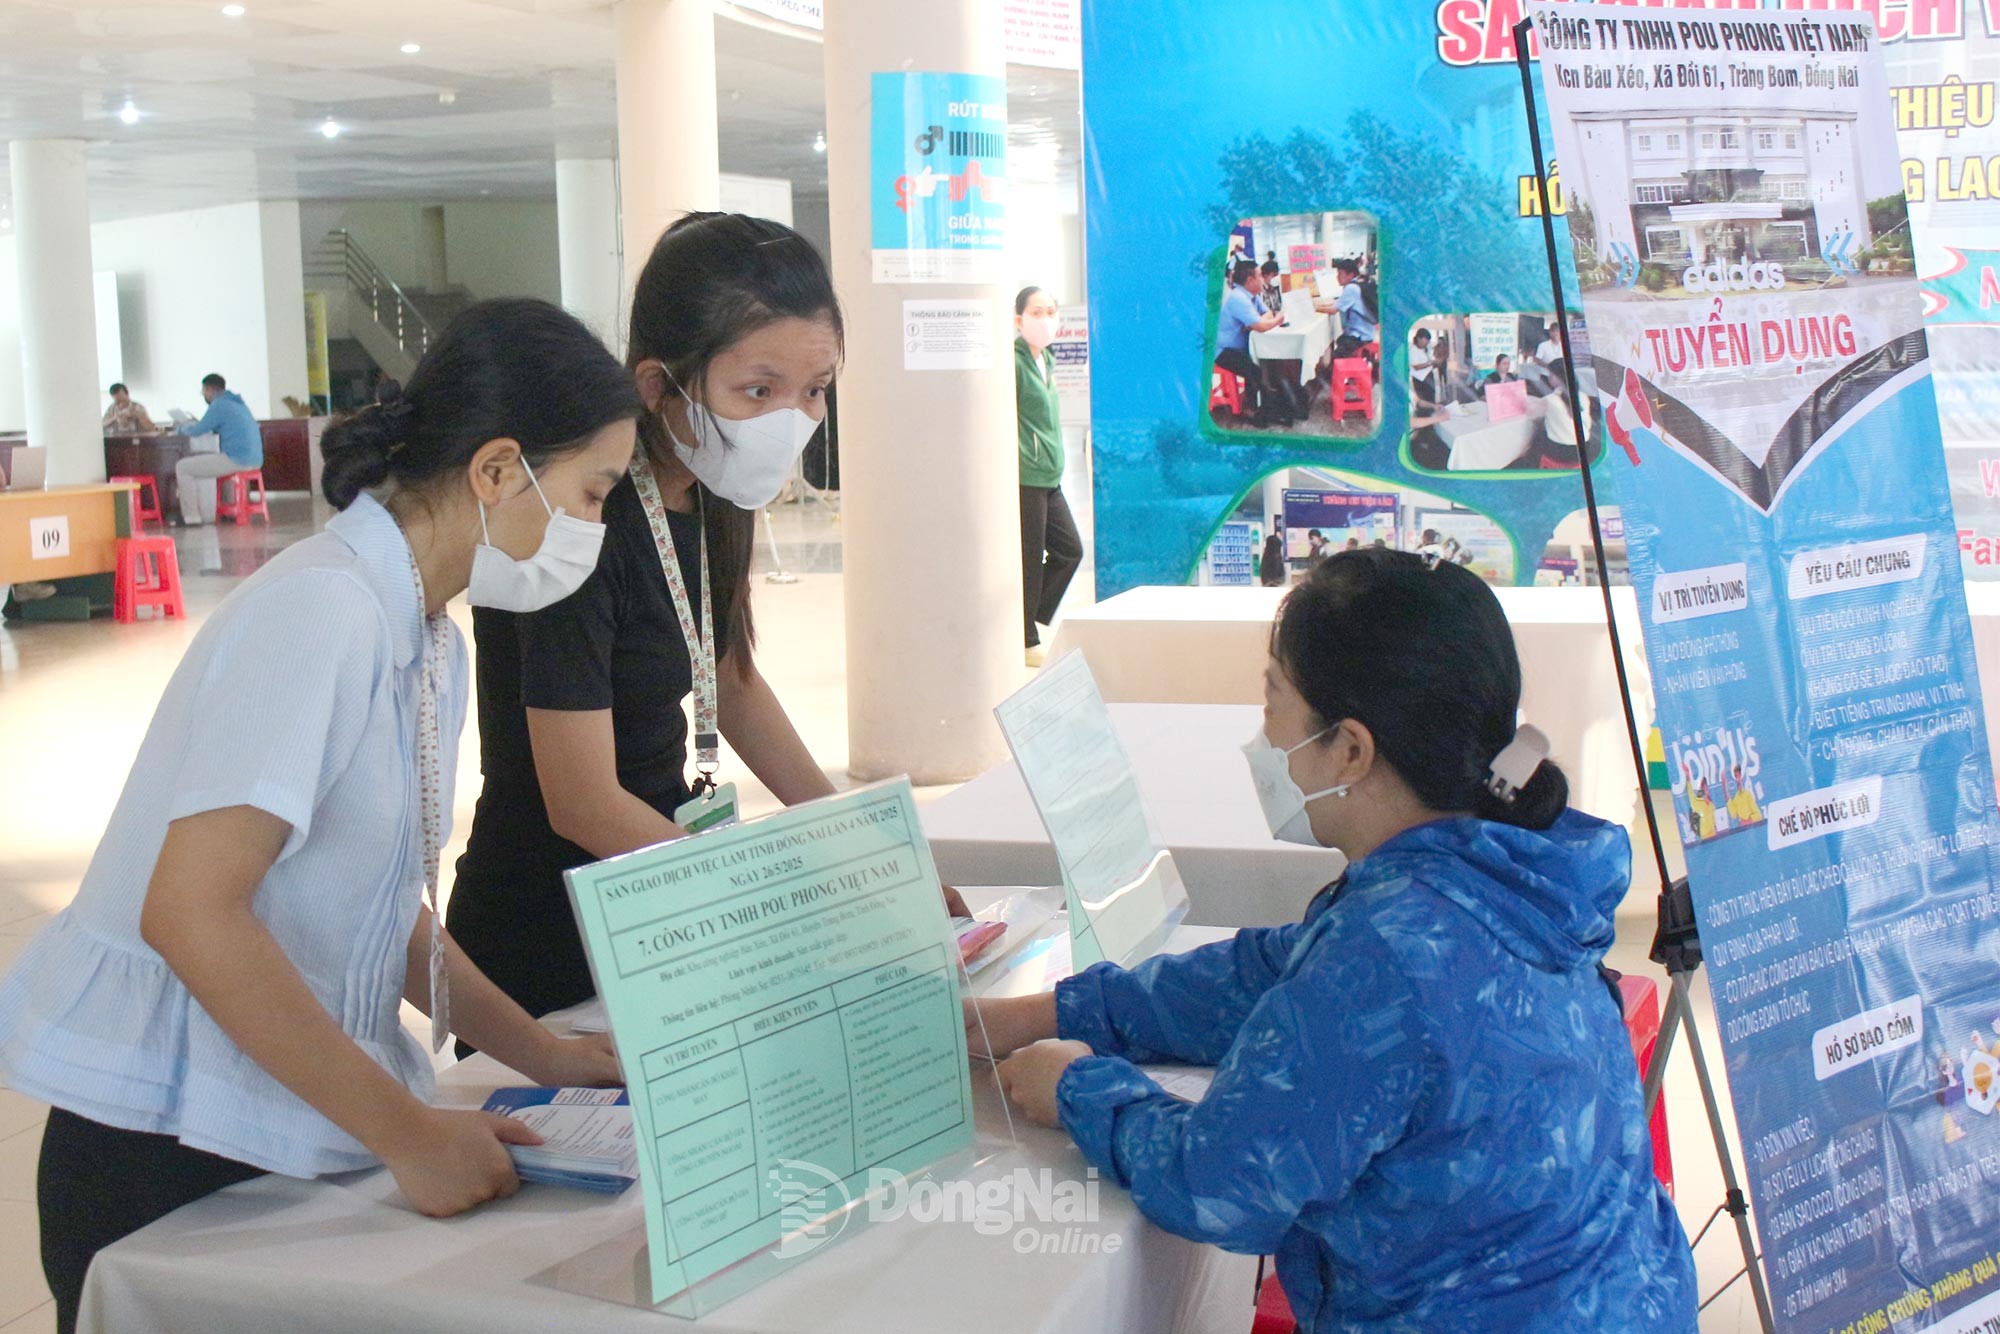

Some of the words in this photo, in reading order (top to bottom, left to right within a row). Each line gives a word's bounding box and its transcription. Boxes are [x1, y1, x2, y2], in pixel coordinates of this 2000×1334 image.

[1537, 9, 1591, 51] CÔNG
[1595, 18, 1618, 50] TY
[1622, 19, 1680, 51] TNHH
[1680, 21, 1719, 51] POU
[1718, 22, 1786, 52] PHONG
[1784, 17, 1825, 58] VIỆT
[1825, 23, 1869, 52] NAM
[1554, 63, 1581, 89] Kcn
[1585, 63, 1612, 90] Bàu
[1653, 61, 1674, 89] Xã
[1702, 64, 1725, 91] 61,
[1728, 61, 1765, 91] Trảng
[1838, 63, 1860, 89] Nai
[947, 99, 979, 118] RÚT
[1682, 254, 1786, 293] adidas
[1644, 297, 1751, 373] TUYỂN
[1760, 313, 1857, 375] DỤNG
[42, 528, 60, 550] 09
[1805, 560, 1832, 585] YÊU
[1836, 553, 1861, 580] CẦU
[1865, 550, 1911, 576] CHUNG
[1720, 580, 1746, 605] DỤNG
[1838, 696, 1871, 725] TIẾNG
[1778, 803, 1799, 838] CHẾ
[1813, 797, 1849, 826] PHÚC
[631, 874, 662, 895] GIAO
[663, 865, 693, 887] DỊCH
[692, 854, 721, 876] VIỆC
[879, 805, 899, 822] 2025
[729, 869, 761, 890] NGÀY
[637, 939, 652, 957] 7.
[652, 925, 696, 953] CÔNG
[696, 918, 717, 938] TY
[718, 903, 760, 931] TNHH
[760, 895, 788, 918] POU
[790, 879, 838, 909] PHONG
[838, 868, 869, 892] VIỆT
[869, 859, 901, 882] NAM
[1859, 1026, 1885, 1051] BAO
[1886, 1286, 1932, 1324] CHỨNG
[1931, 1267, 1973, 1303] KHÔNG
[1972, 1251, 1998, 1285] QUÁ
